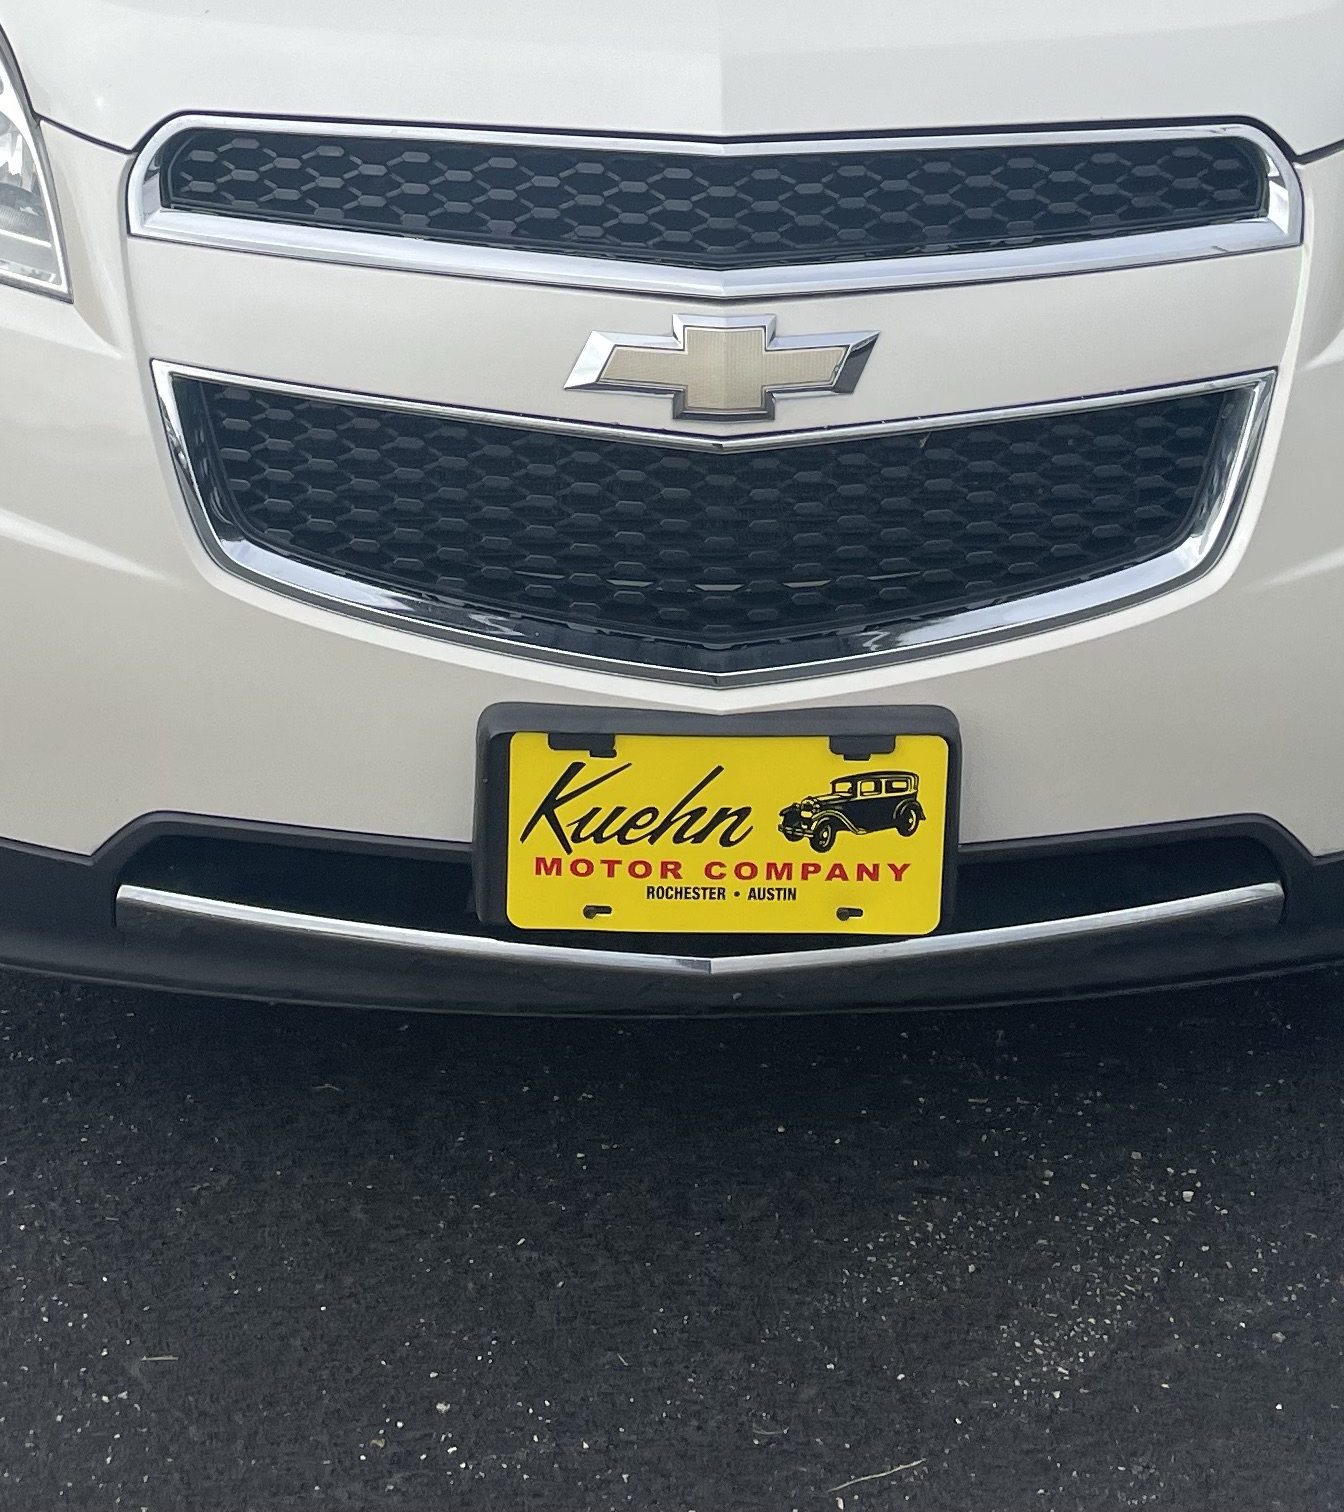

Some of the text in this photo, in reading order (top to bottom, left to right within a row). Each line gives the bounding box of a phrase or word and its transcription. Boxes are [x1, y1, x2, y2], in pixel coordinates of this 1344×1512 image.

[519, 760, 755, 856] Kuehn
[533, 855, 913, 884] MOTOR COMPANY
[645, 884, 798, 903] ROCHESTER AUSTIN
